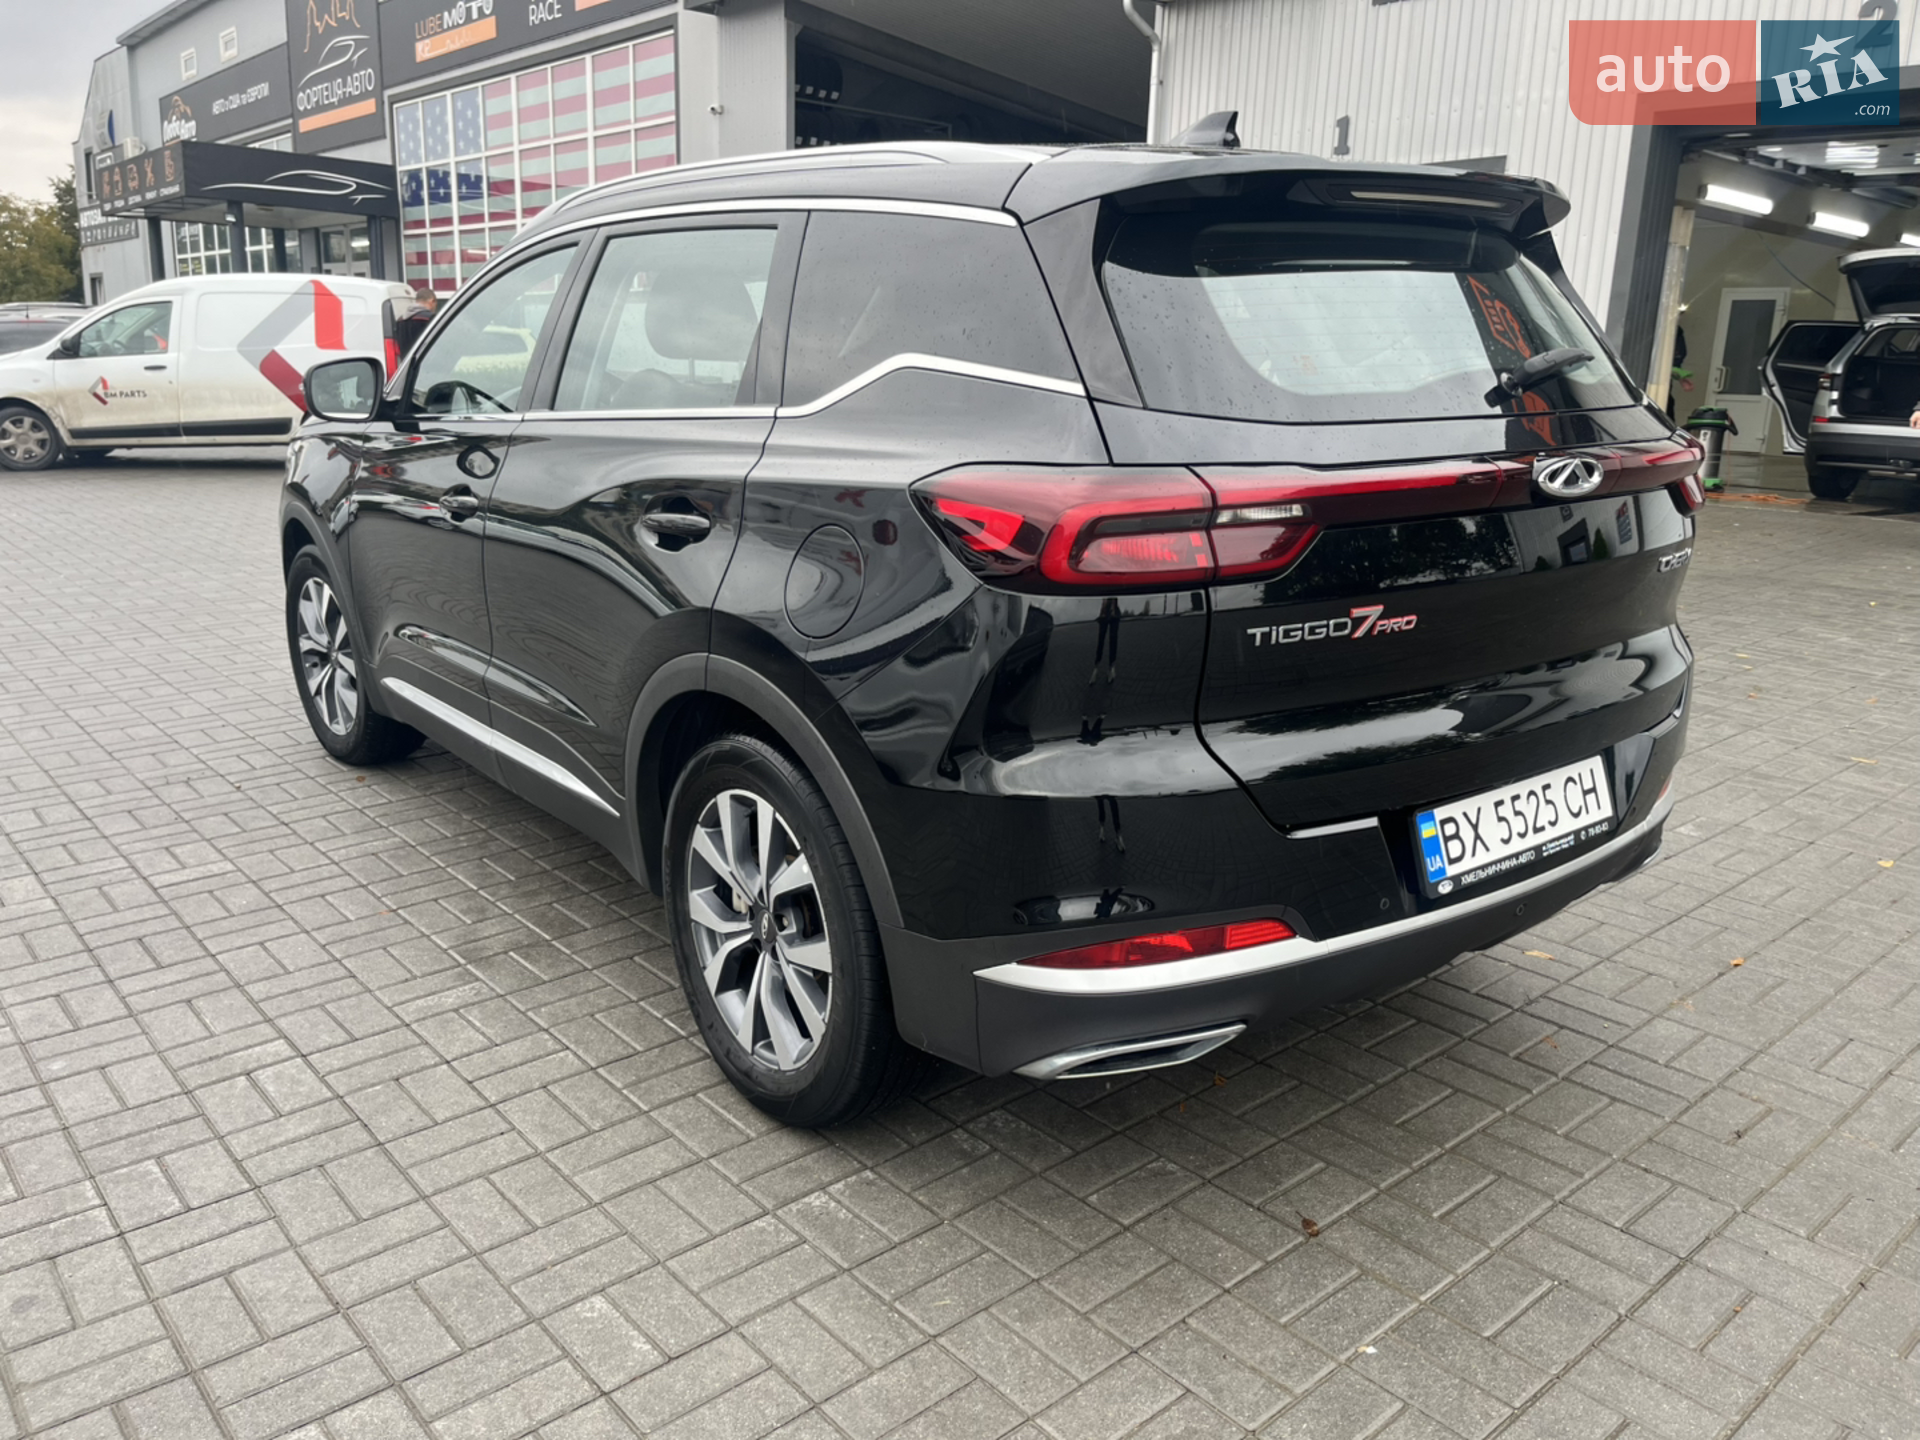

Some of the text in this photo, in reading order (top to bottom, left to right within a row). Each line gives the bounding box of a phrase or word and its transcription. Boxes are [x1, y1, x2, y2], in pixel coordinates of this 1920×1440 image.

[529, 0, 562, 25] RACE
[297, 68, 376, 112] ФОРТЕЦЯ-АВТО
[1333, 114, 1350, 156] 1
[119, 390, 148, 399] PARTS
[1438, 768, 1601, 866] BX 5525 CH
[1427, 854, 1444, 871] UA
